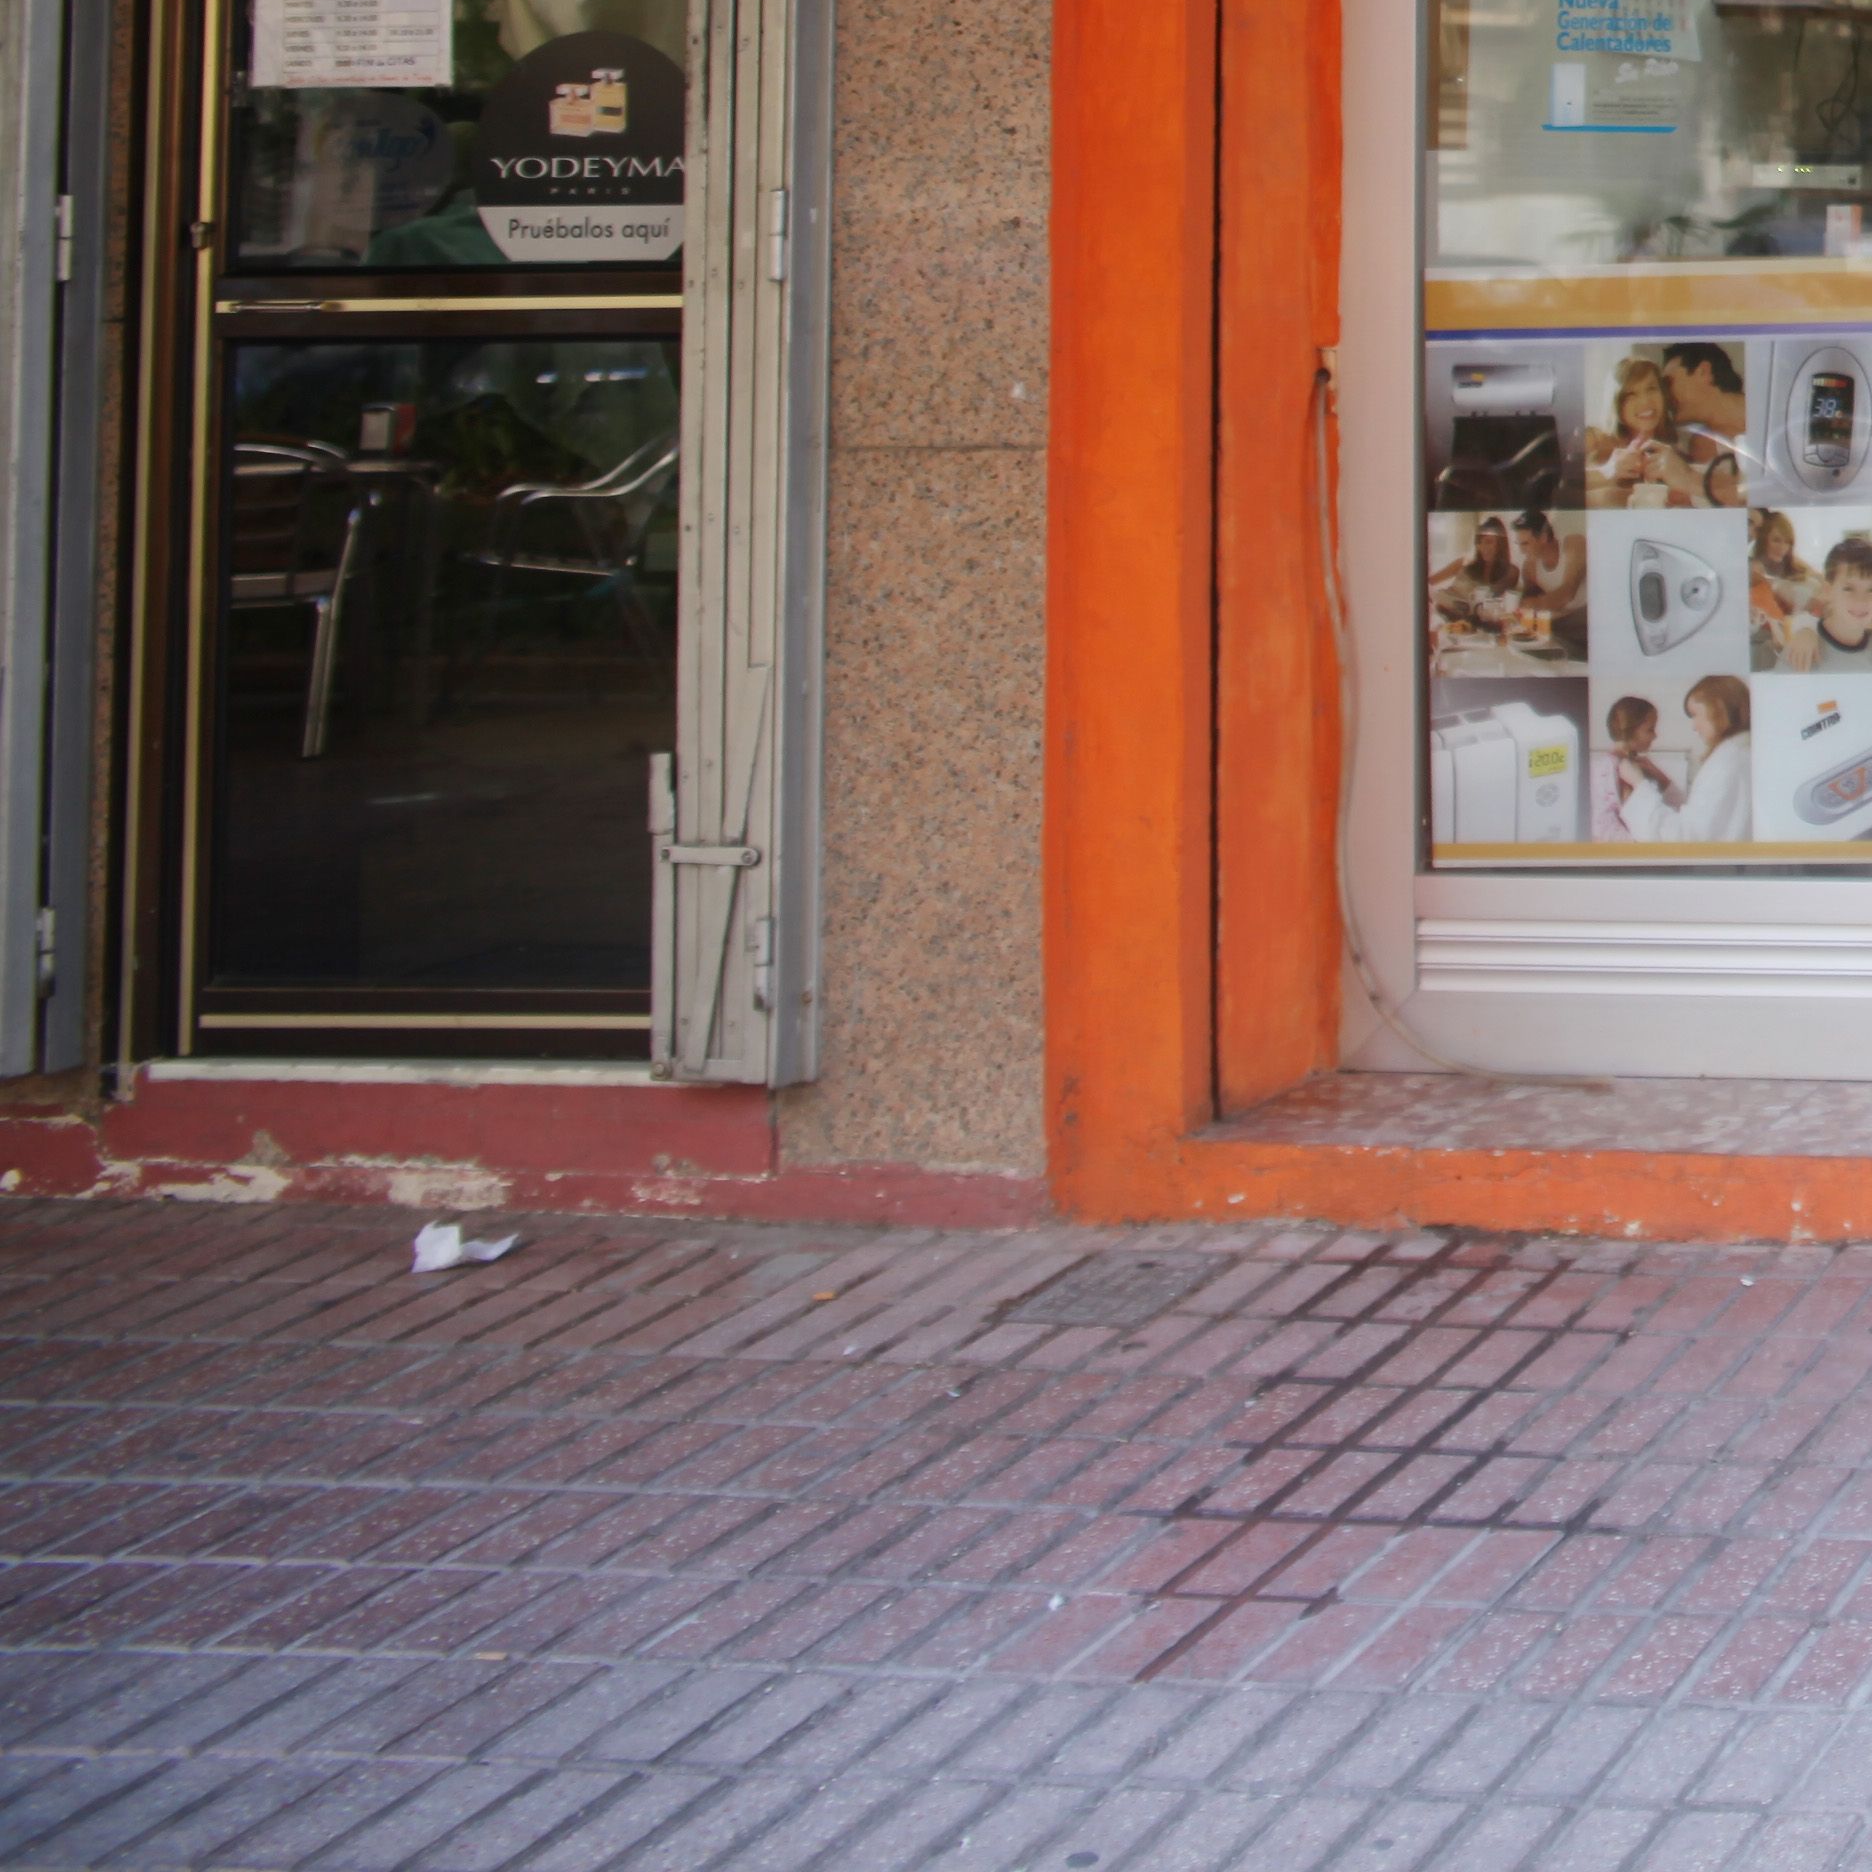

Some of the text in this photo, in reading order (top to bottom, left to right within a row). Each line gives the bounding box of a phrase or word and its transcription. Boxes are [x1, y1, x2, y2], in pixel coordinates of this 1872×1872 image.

[1557, 10, 1673, 32] Generación de
[1557, 32, 1672, 53] Calentadores
[490, 155, 685, 179] YODEYMA
[508, 215, 671, 241] Pruébalos aquí
